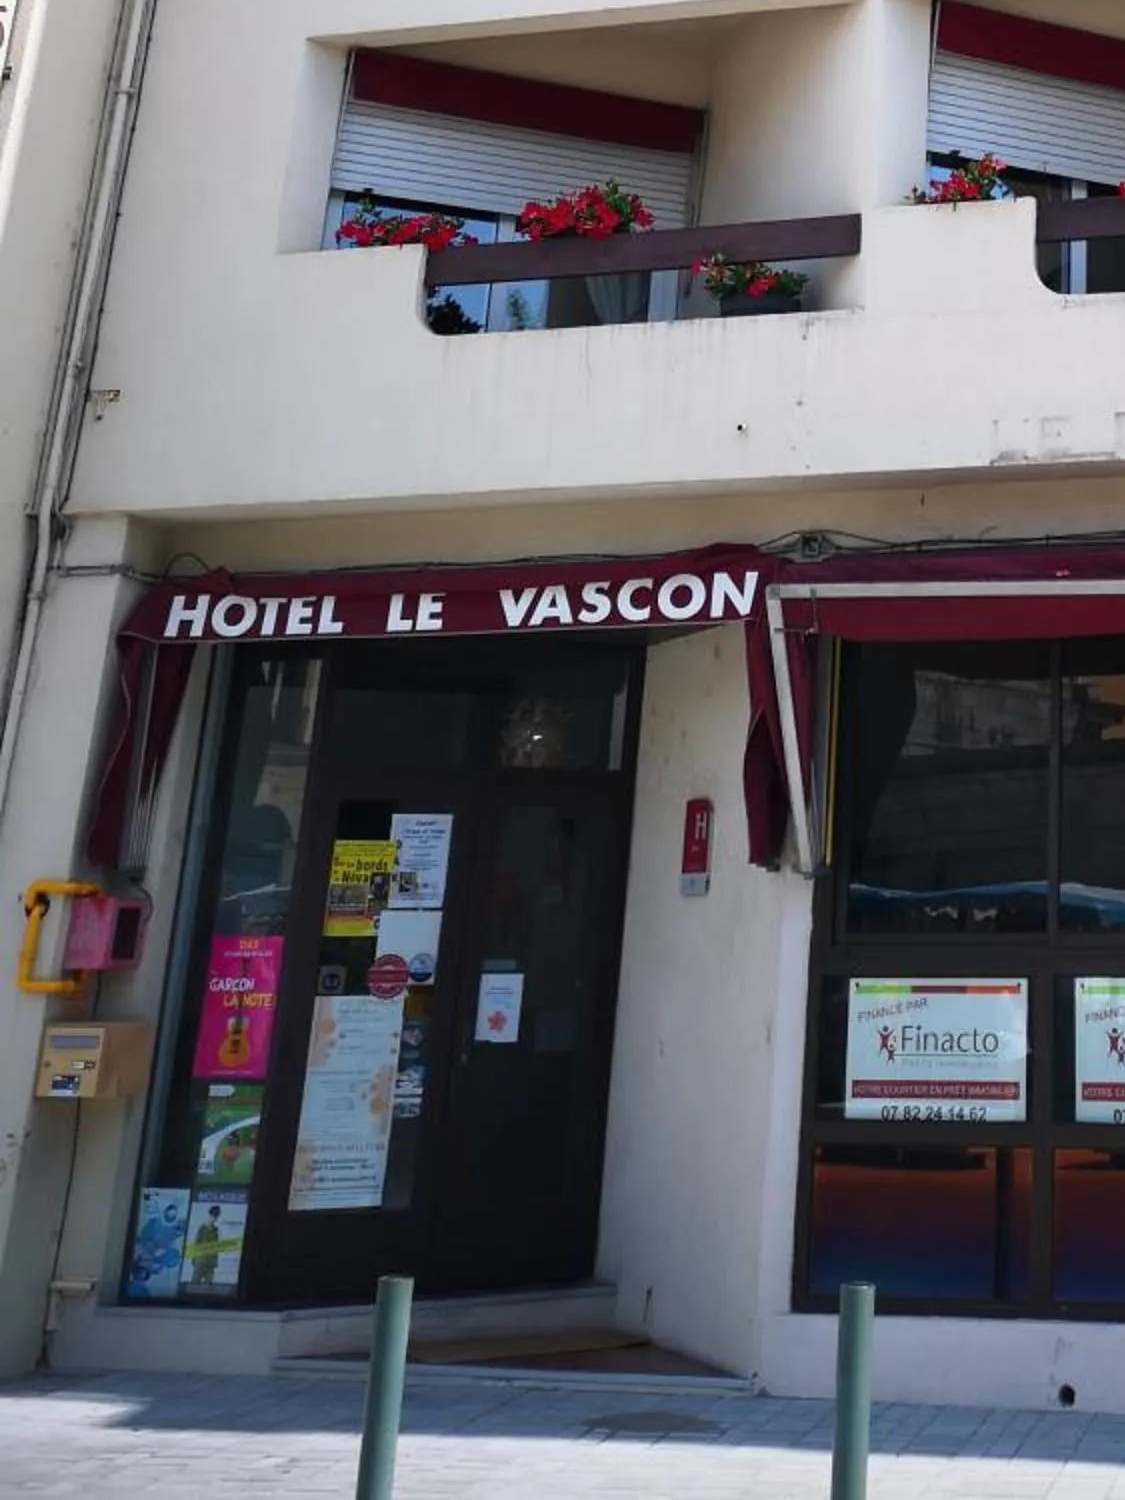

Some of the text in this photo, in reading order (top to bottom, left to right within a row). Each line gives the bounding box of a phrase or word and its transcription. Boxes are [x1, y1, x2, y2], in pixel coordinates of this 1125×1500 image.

[163, 571, 760, 638] HOTEL LE VASCON
[901, 1024, 999, 1053] Finacto
[880, 1105, 988, 1122] 07 82 24 14 62
